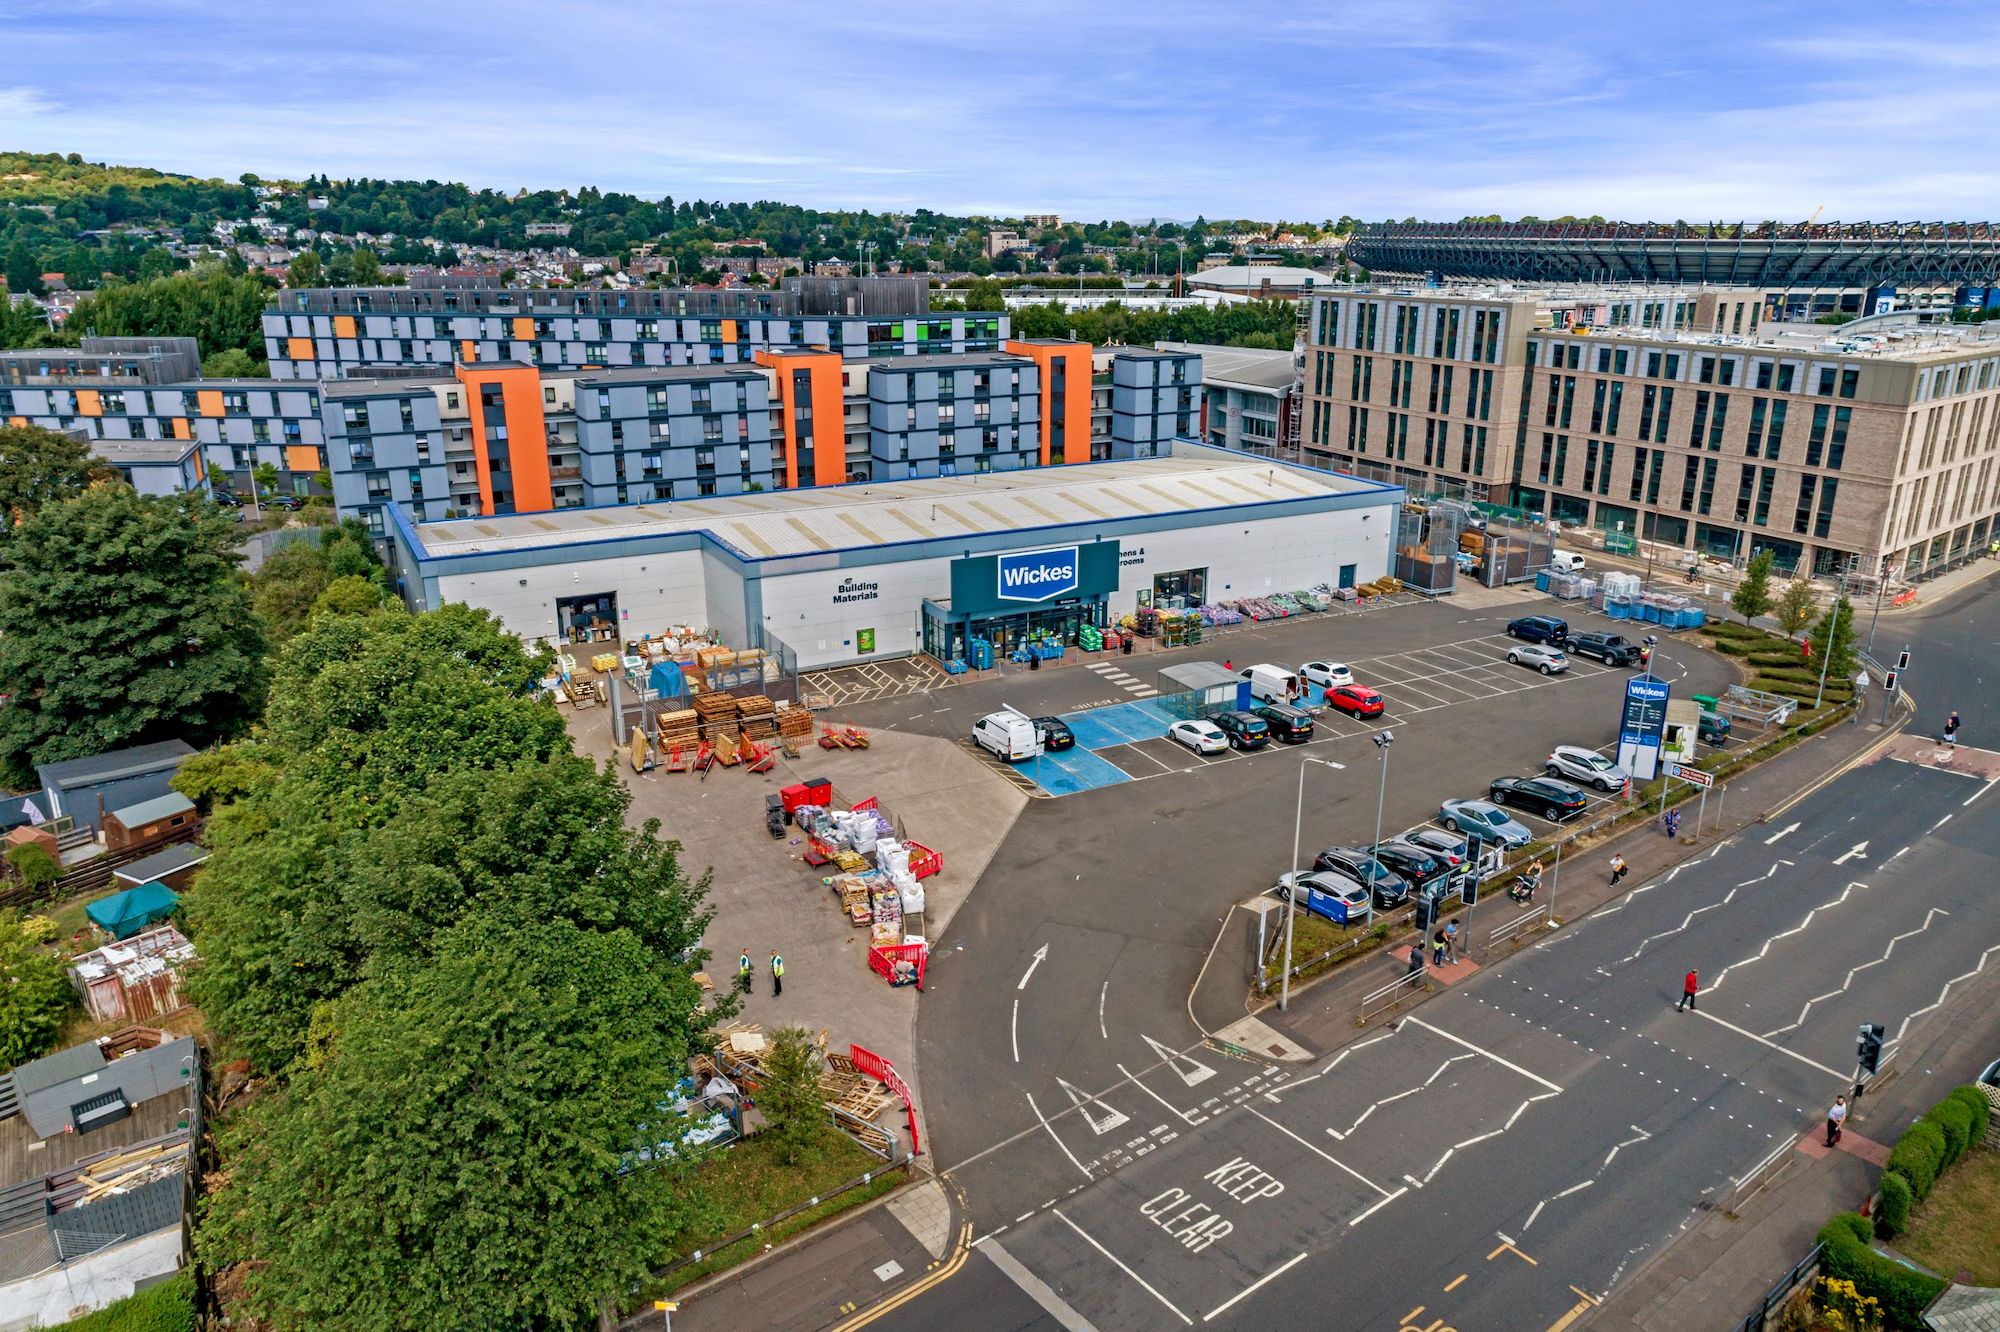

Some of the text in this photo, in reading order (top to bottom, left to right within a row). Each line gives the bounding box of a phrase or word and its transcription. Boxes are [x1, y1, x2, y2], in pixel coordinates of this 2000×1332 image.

[1139, 547, 1145, 555] &
[1120, 558, 1145, 566] rooms
[1004, 565, 1073, 587] Wickes
[838, 582, 878, 593] Building
[833, 592, 878, 604] Materials
[1204, 1157, 1285, 1204] KEEP
[1140, 1187, 1234, 1253] CLEAR
